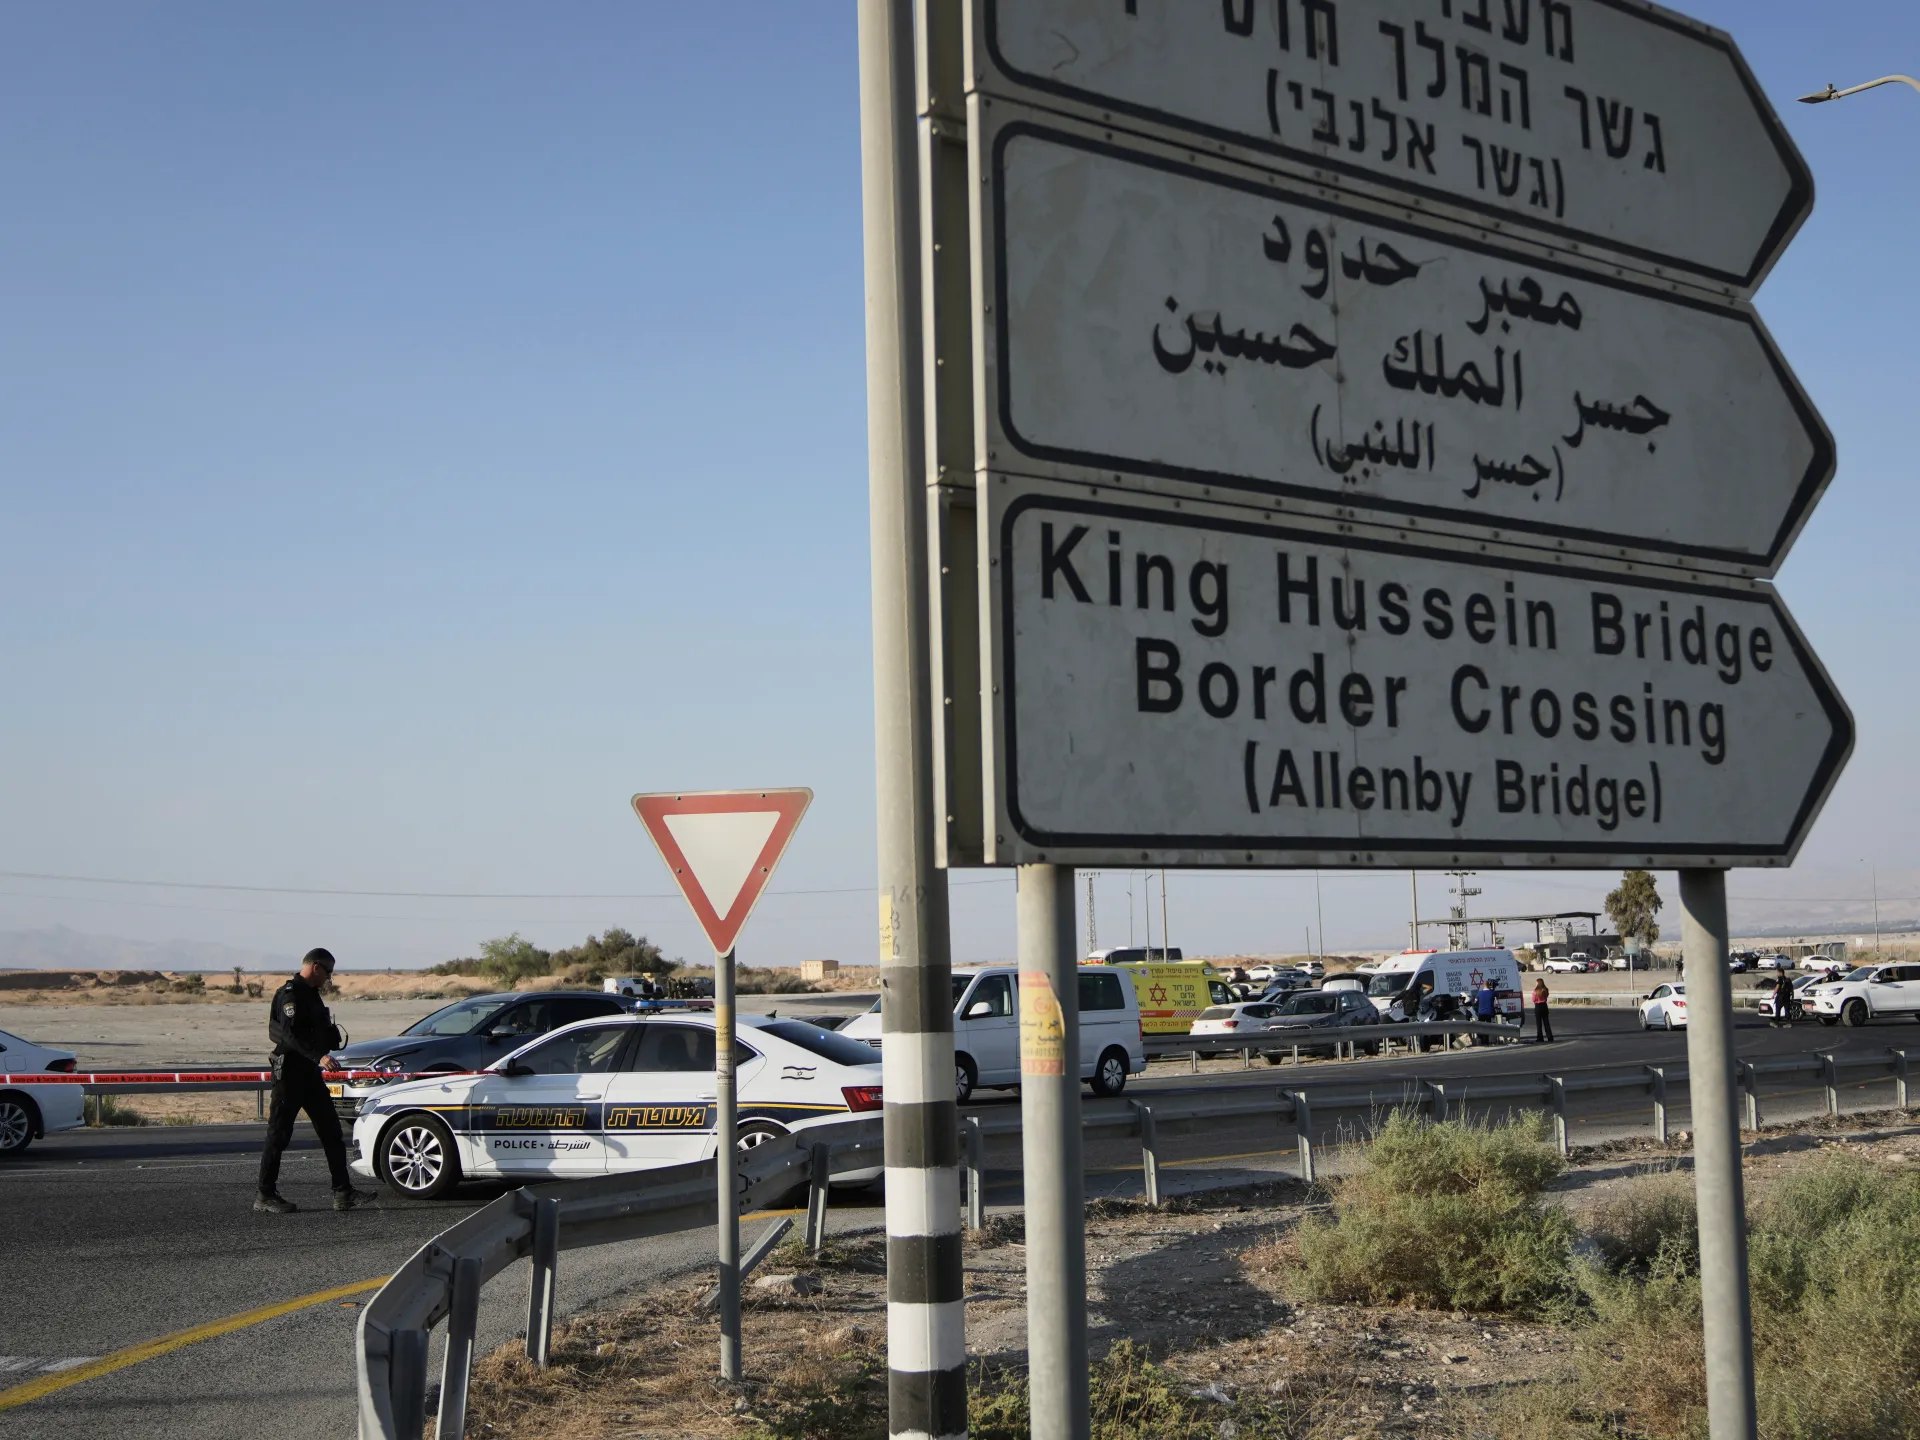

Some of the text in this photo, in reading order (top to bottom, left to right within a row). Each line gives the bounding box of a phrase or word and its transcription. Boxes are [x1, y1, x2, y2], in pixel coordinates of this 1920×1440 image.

[1378, 20, 1530, 130] המלך
[1441, 0, 1574, 63] מעב
[1267, 68, 1565, 218] (גשר אלנבי)
[1564, 85, 1666, 173] גשר
[1262, 215, 1583, 335] معبر حدود
[1153, 295, 1671, 454] جسر الملك حسين
[1310, 404, 1564, 502] (جسر اللنبي)
[1040, 522, 1774, 685] King Hussein Bridge
[1135, 637, 1727, 765] Border Crossing
[1244, 740, 1662, 831] (Allenby Bridge)
[1172, 999, 1196, 1007] בישראל
[494, 1139, 591, 1151] POLICE الشرطة
[496, 1107, 706, 1127] משטרת התנועה
